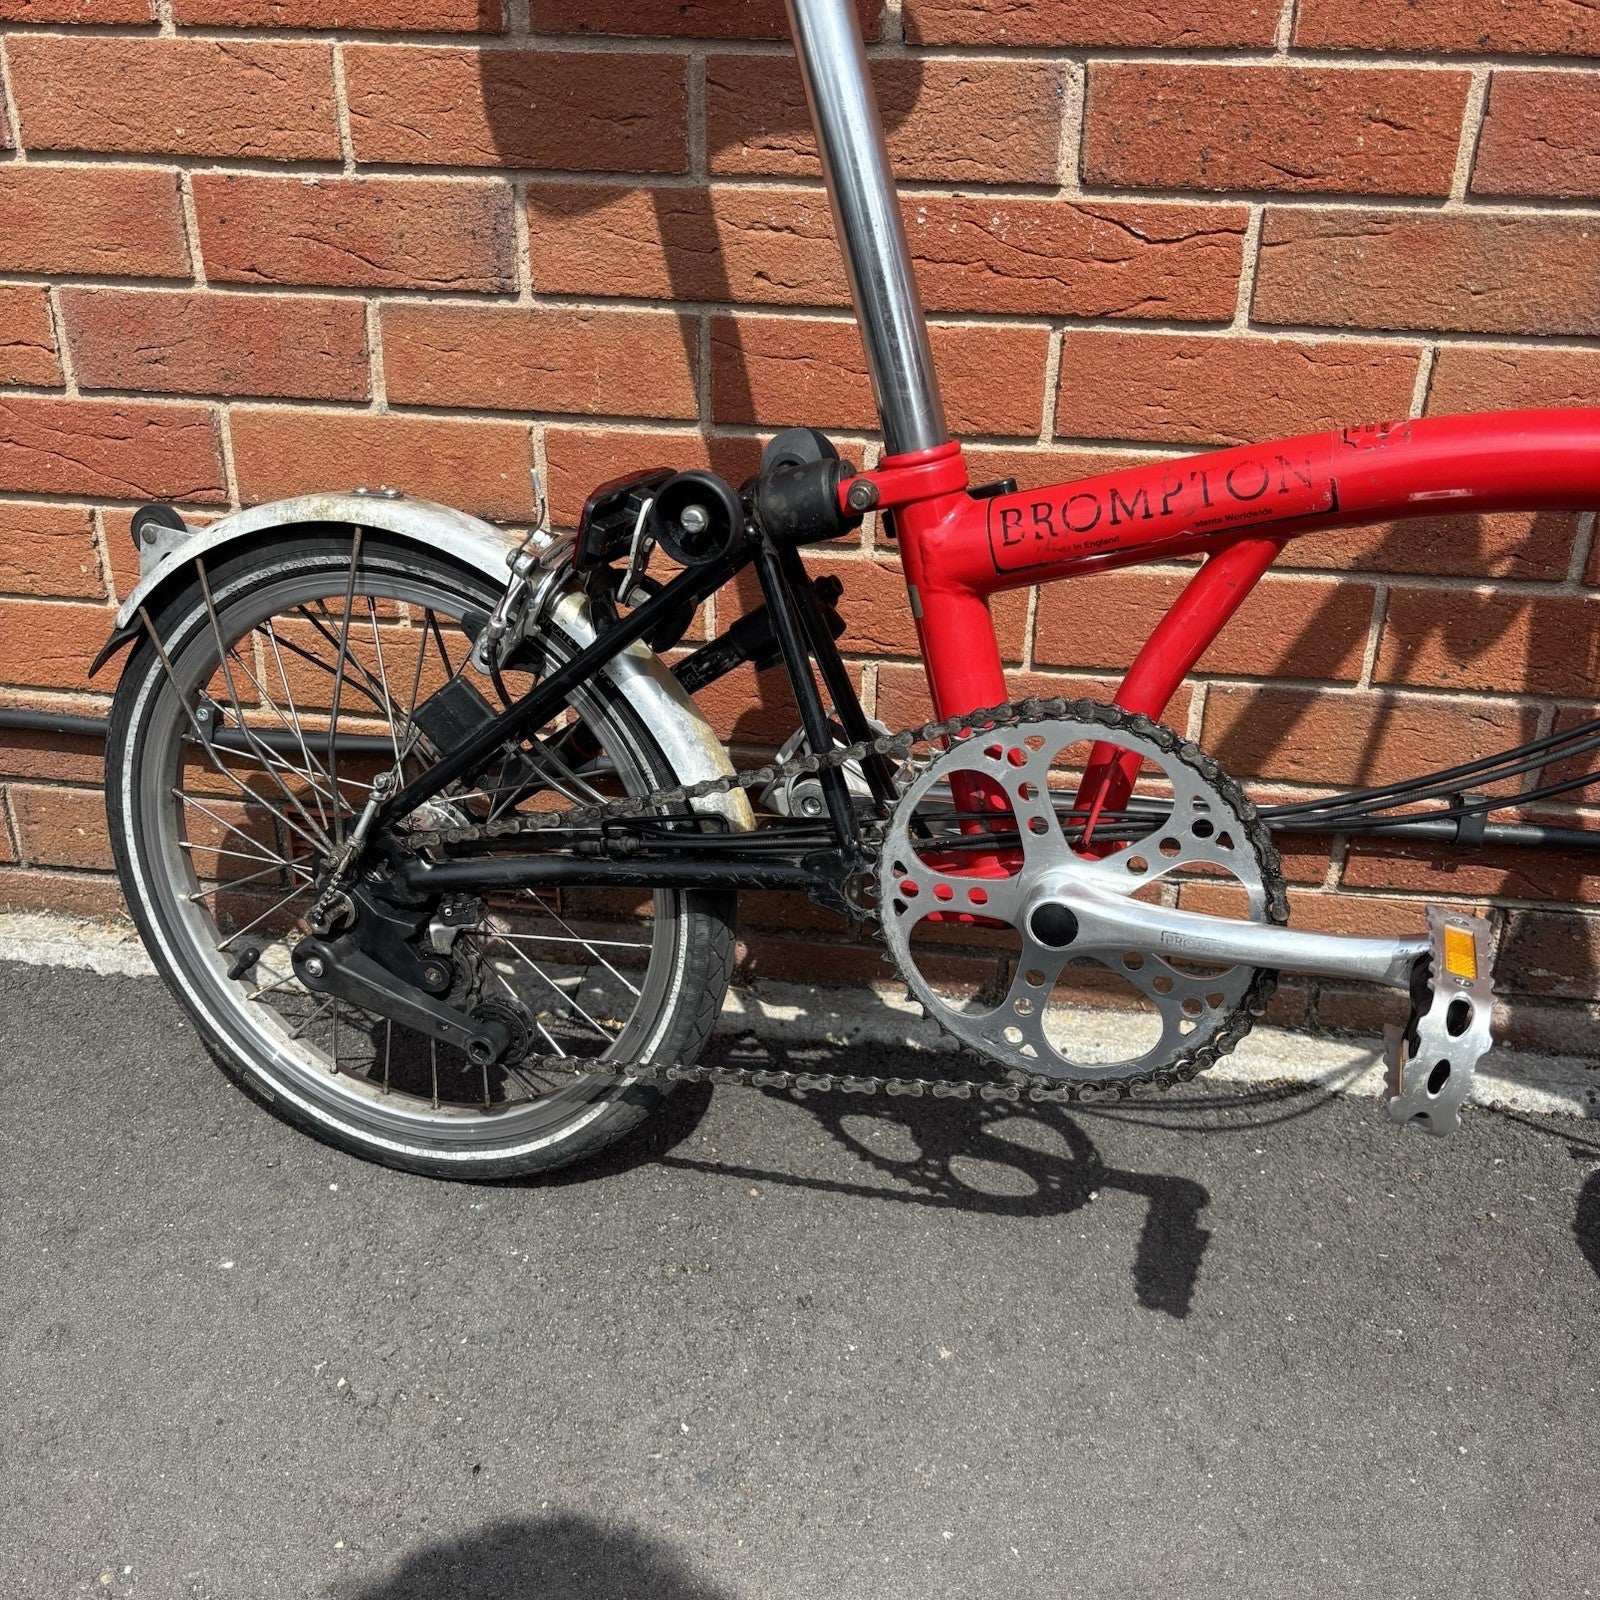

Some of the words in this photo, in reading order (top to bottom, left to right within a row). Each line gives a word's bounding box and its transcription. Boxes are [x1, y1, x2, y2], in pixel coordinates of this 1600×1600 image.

[1000, 450, 1314, 547] BROMPTON
[1224, 507, 1274, 522] Worldwide
[1083, 535, 1120, 549] England
